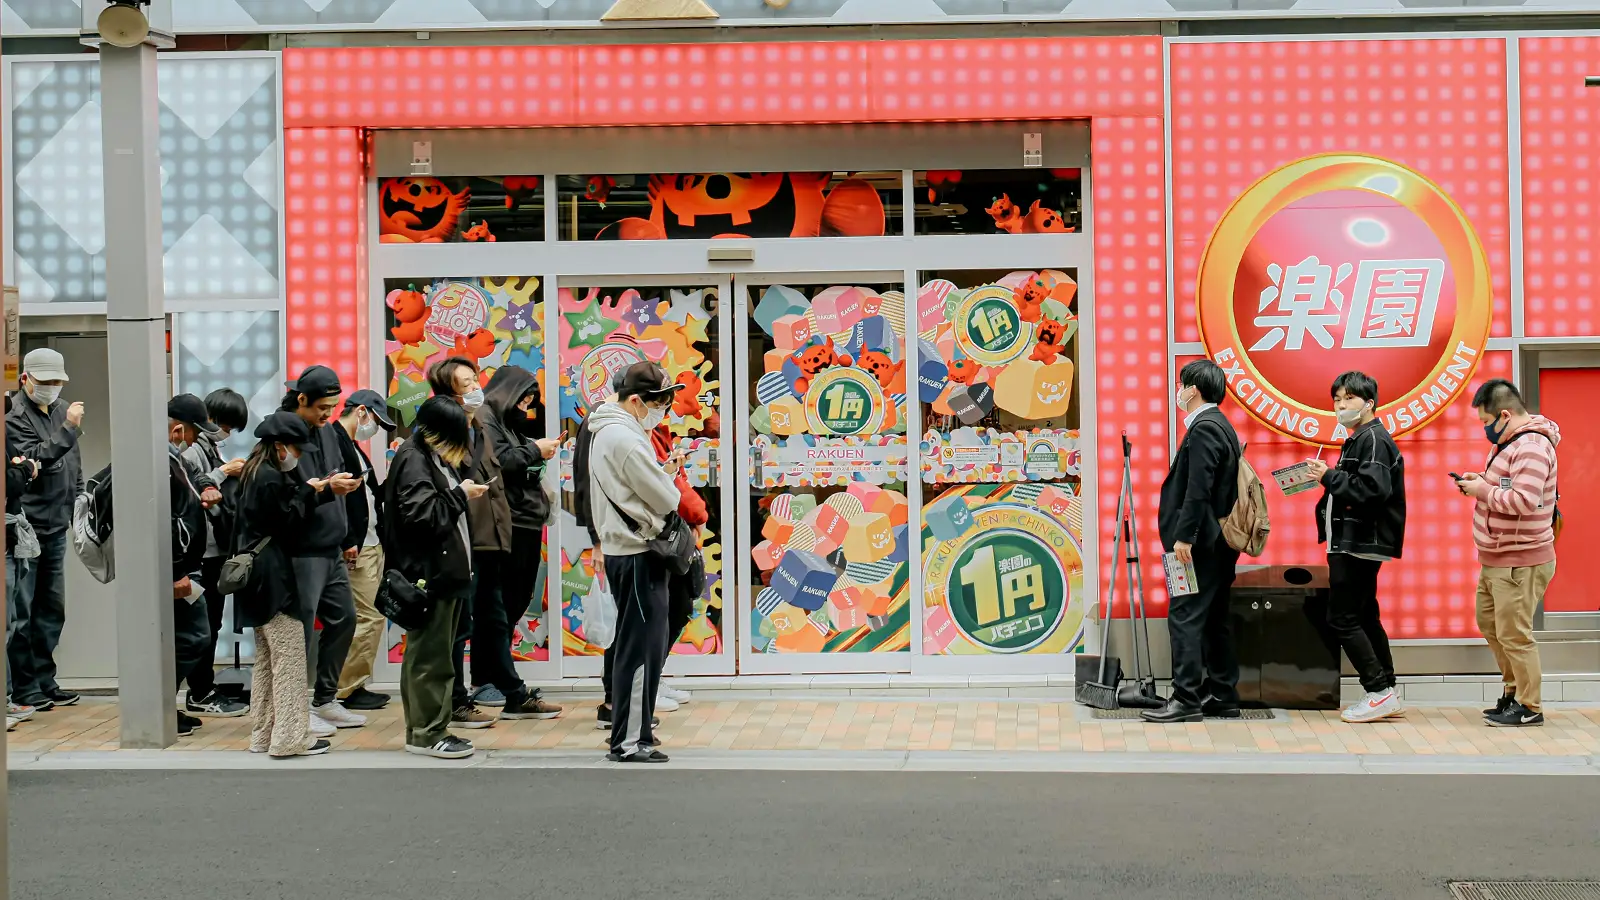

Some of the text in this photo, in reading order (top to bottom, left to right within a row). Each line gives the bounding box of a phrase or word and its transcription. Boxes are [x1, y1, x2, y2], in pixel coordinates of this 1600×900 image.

[840, 302, 859, 317] RAKUEN
[921, 303, 941, 318] RAKUEN
[1248, 255, 1445, 352] 楽園
[970, 306, 1013, 344] 1円
[918, 375, 944, 390] RAKUEN
[1214, 340, 1478, 443] EXCITING AUSEMENT
[396, 391, 426, 407] RAKUEN
[825, 384, 865, 420] 1円
[807, 449, 864, 459] RAKUEN
[1002, 513, 1064, 547] PACHINKO
[998, 554, 1032, 574] 楽園の
[561, 579, 589, 591] RAKUEN
[777, 566, 799, 588] RAKUEN
[960, 545, 1046, 626] 1円
[801, 585, 828, 598] RAKUEN
[991, 614, 1045, 643] パチンコ
